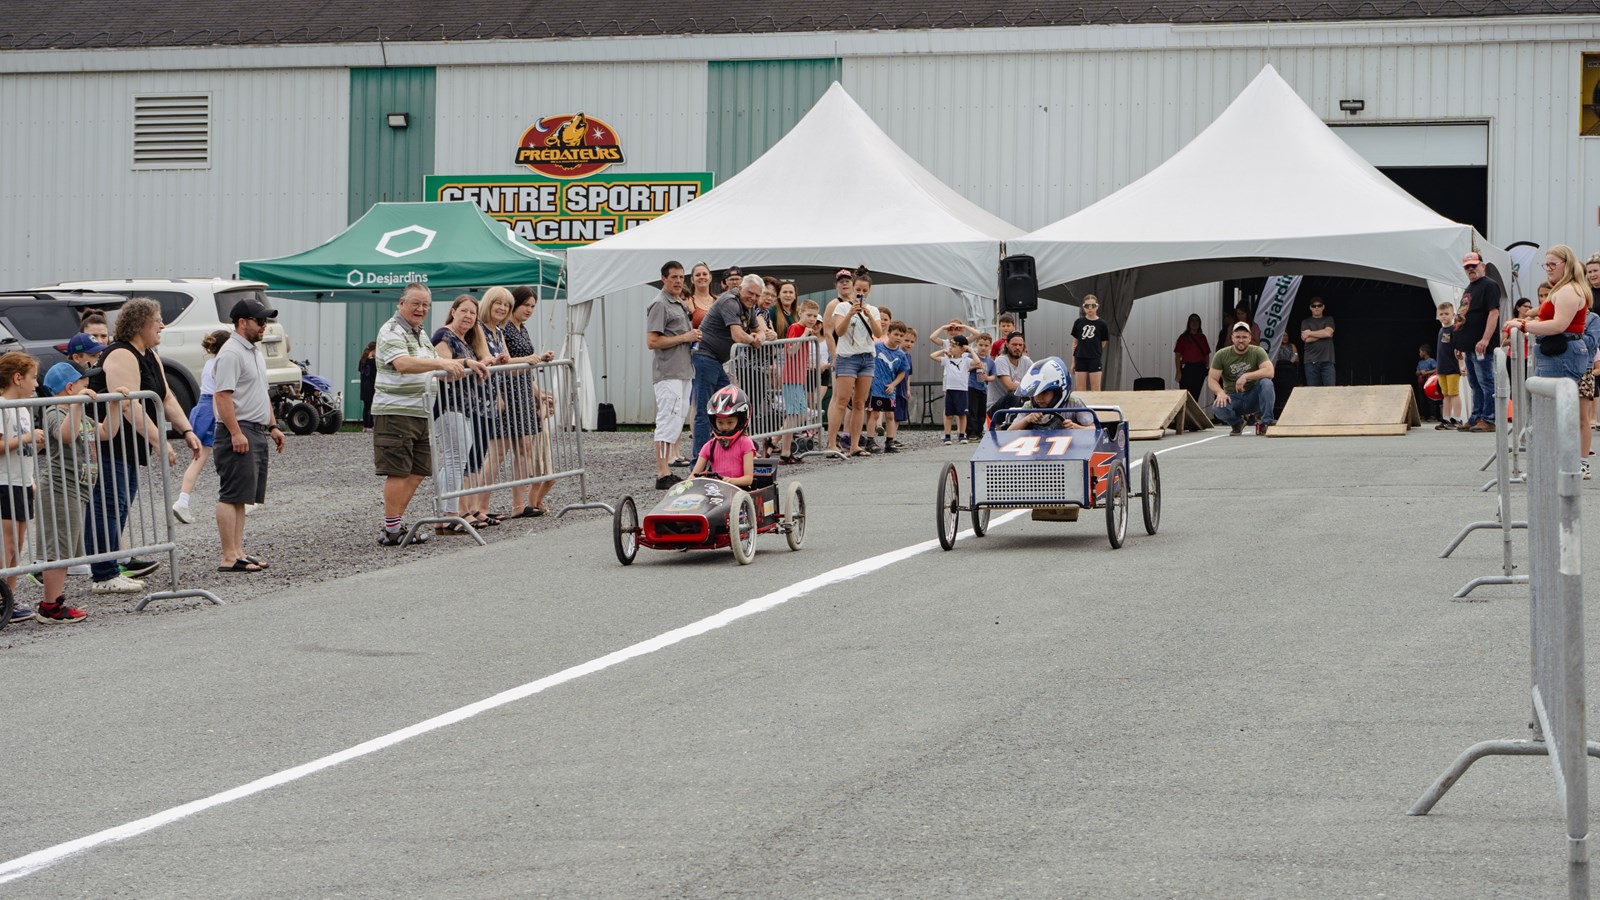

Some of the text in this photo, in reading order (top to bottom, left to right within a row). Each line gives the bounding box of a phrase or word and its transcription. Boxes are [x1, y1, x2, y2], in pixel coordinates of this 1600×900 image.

[519, 148, 620, 161] PRÉDATEURS
[366, 271, 428, 286] Desjardins
[999, 435, 1073, 457] 41
